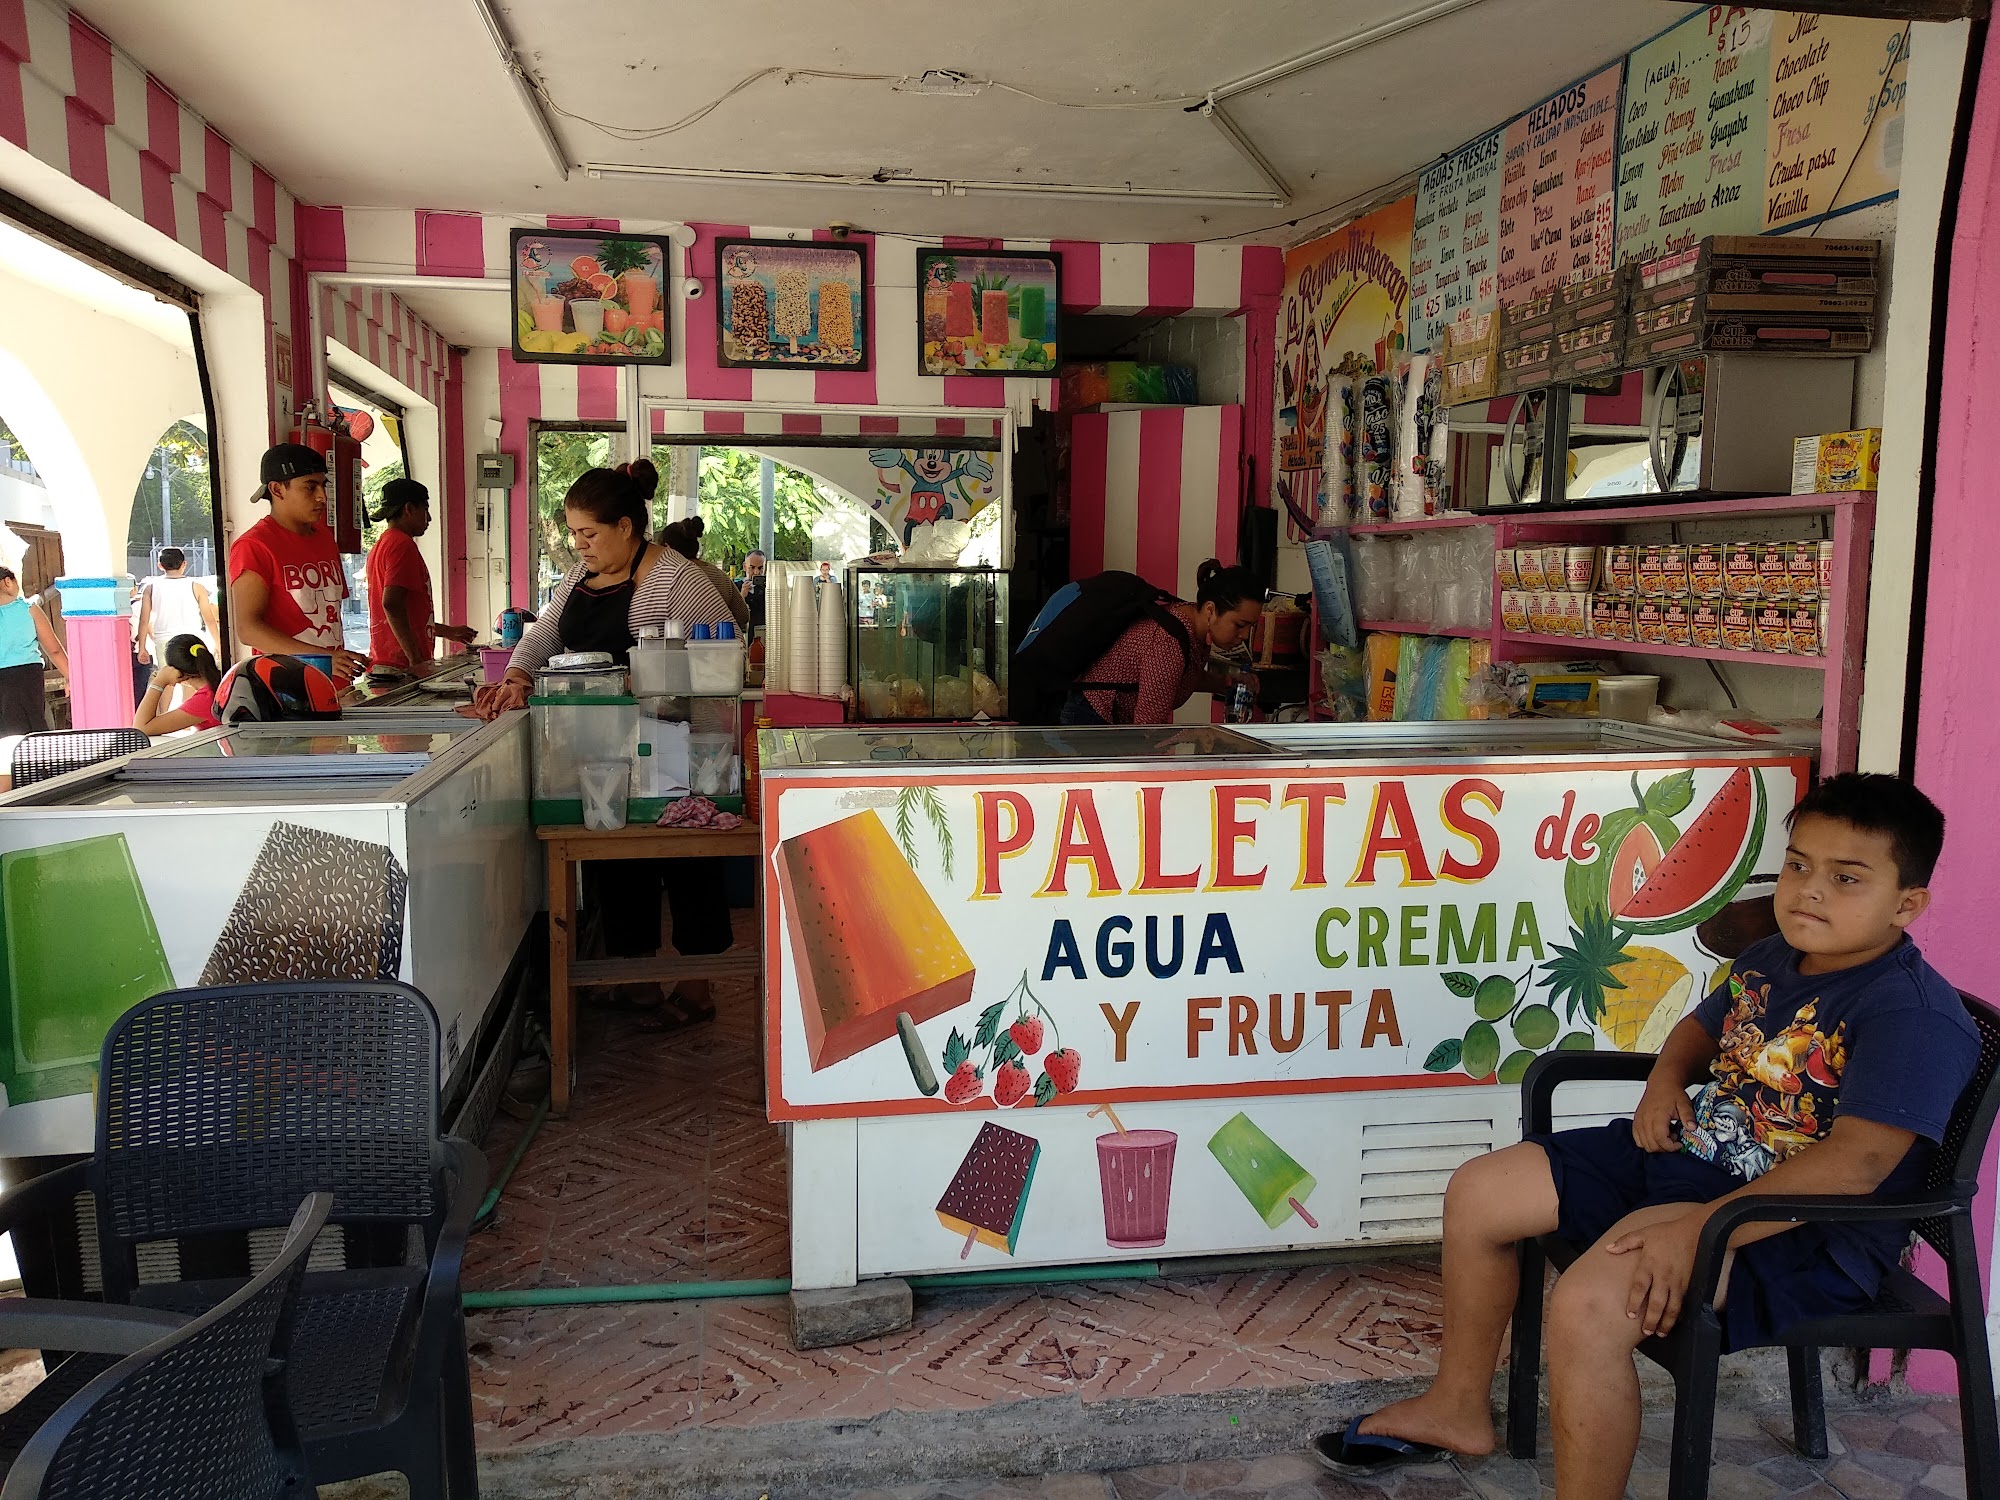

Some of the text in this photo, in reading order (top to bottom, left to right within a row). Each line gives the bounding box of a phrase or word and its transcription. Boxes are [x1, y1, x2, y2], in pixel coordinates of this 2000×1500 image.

[1788, 14, 1820, 44] Nuez
[1713, 55, 1739, 83] Nance
[1775, 37, 1830, 83] Chocolate
[1664, 77, 1690, 105] Piña
[1707, 79, 1755, 122] Guanabana
[1773, 73, 1830, 119] Choco Chip
[1527, 83, 1586, 135] HELADOS
[1628, 101, 1648, 123] Coco
[1664, 107, 1696, 137] Chamoy
[1533, 122, 1562, 149] CALIDAD
[1580, 120, 1605, 153] Galleta
[1709, 111, 1748, 149] Guayaba
[1772, 118, 1811, 159] Fresa
[1423, 134, 1499, 194] AGUAS FRESCAS
[1538, 149, 1558, 169] Limon
[1658, 142, 1679, 170] Piña
[1705, 150, 1742, 183] Fresa
[1806, 147, 1837, 180] pasa
[1440, 177, 1463, 198] FRUTA
[1466, 158, 1497, 186] NATURAL
[1620, 162, 1644, 186] Limon
[1658, 171, 1684, 198] Melon
[1596, 198, 1611, 223] $15
[1623, 191, 1639, 212] Uva
[1658, 192, 1706, 227] Tamarindo
[1711, 184, 1741, 209] Arroz
[1767, 187, 1809, 224] Vainilla
[1616, 213, 1650, 250] Grosella
[1501, 246, 1515, 264] Coco
[1298, 248, 1341, 344] Reyna
[1346, 226, 1409, 321] Michoacan
[1715, 280, 1757, 291] NOODLES
[1725, 269, 1751, 281] CUP
[1425, 295, 1441, 319] $25
[1711, 336, 1753, 348] NOODLES
[1721, 324, 1746, 337] CUP
[283, 560, 343, 591] BORN
[967, 778, 1602, 902] PALETAS de
[1041, 902, 1546, 981] AGUA CREMA
[1100, 988, 1403, 1063] Y FRUTA
